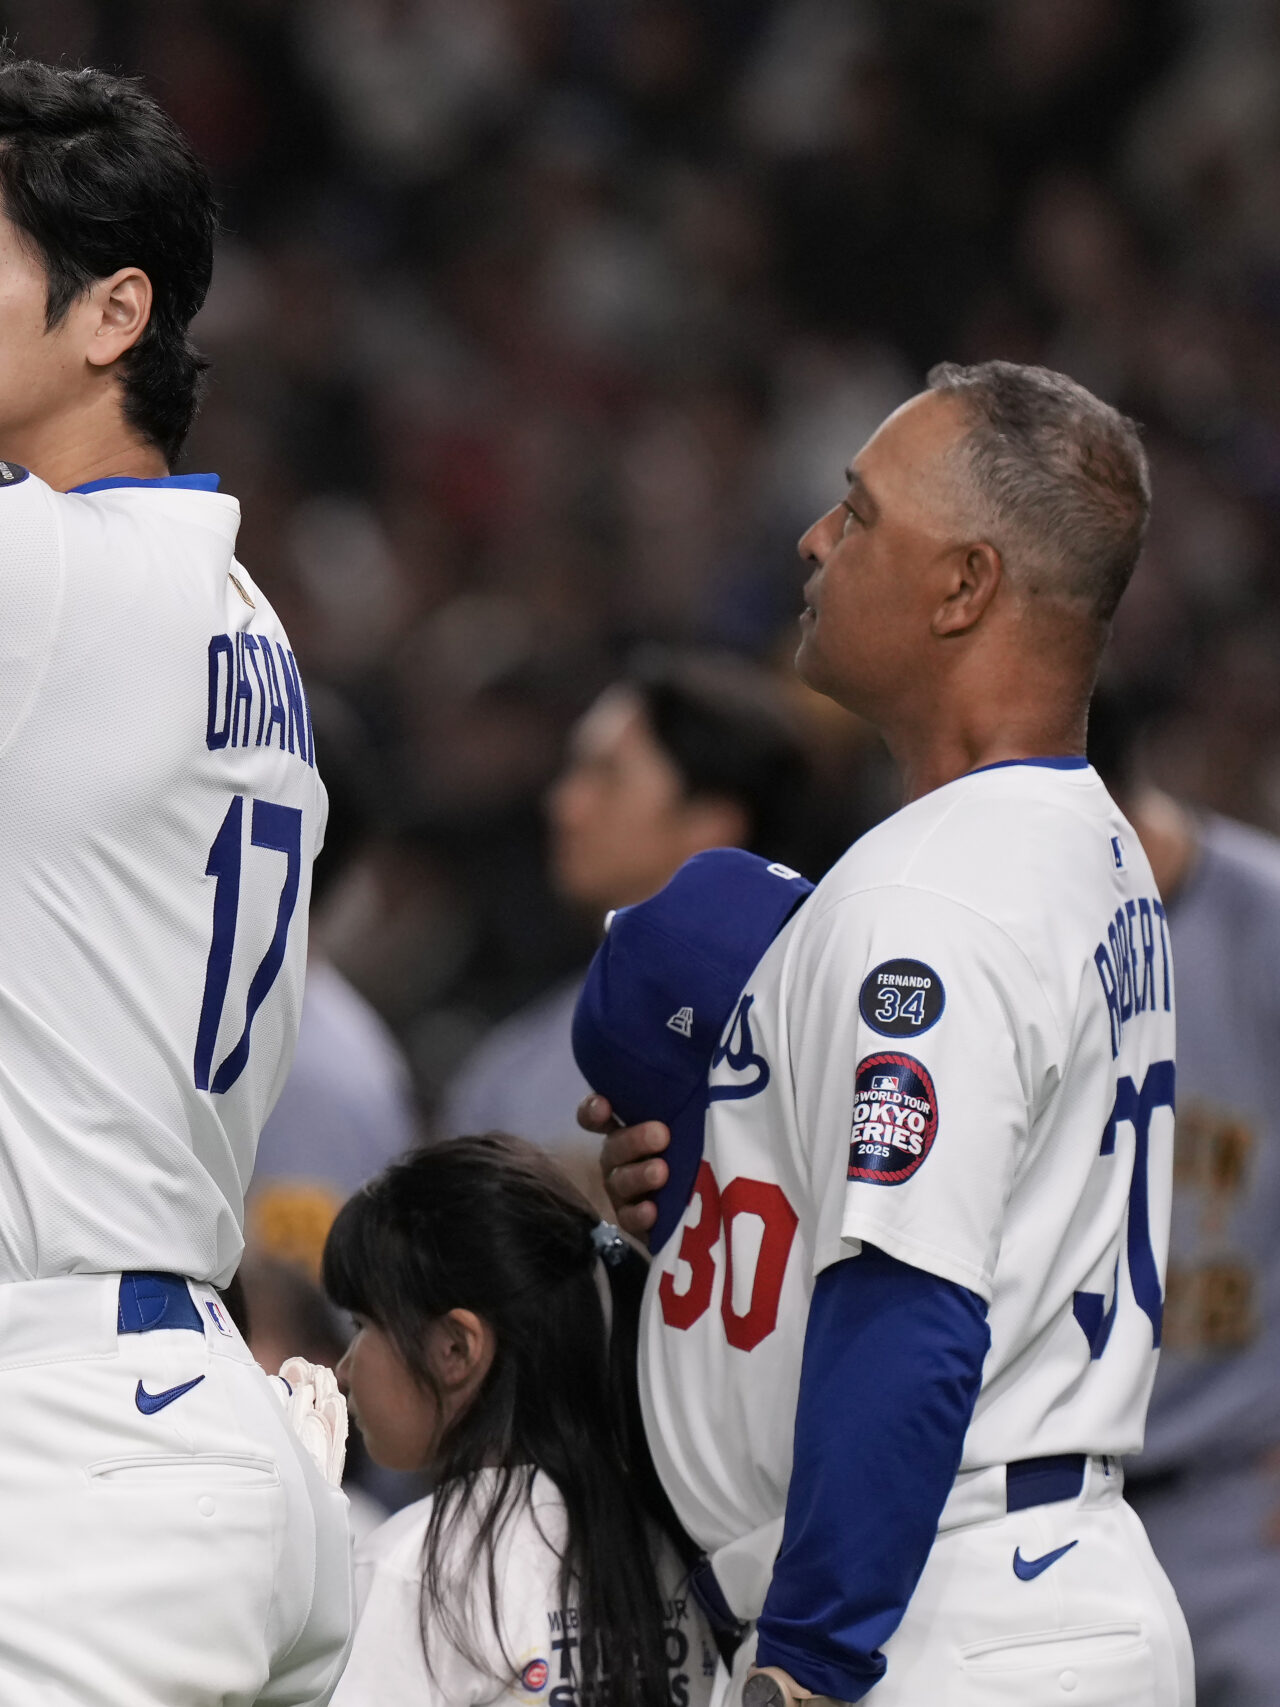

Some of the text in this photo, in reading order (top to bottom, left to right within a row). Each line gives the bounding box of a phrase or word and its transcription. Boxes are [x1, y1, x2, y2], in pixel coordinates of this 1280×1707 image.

[194, 795, 302, 1094] 17
[877, 973, 931, 989] FERNANDO
[875, 988, 926, 1025] 34
[853, 1103, 925, 1133] OKYO
[860, 1091, 902, 1103] WORLD
[904, 1096, 931, 1114] TOUR
[850, 1122, 923, 1155] ERIES
[858, 1144, 890, 1157] 2025
[659, 1158, 799, 1352] 30
